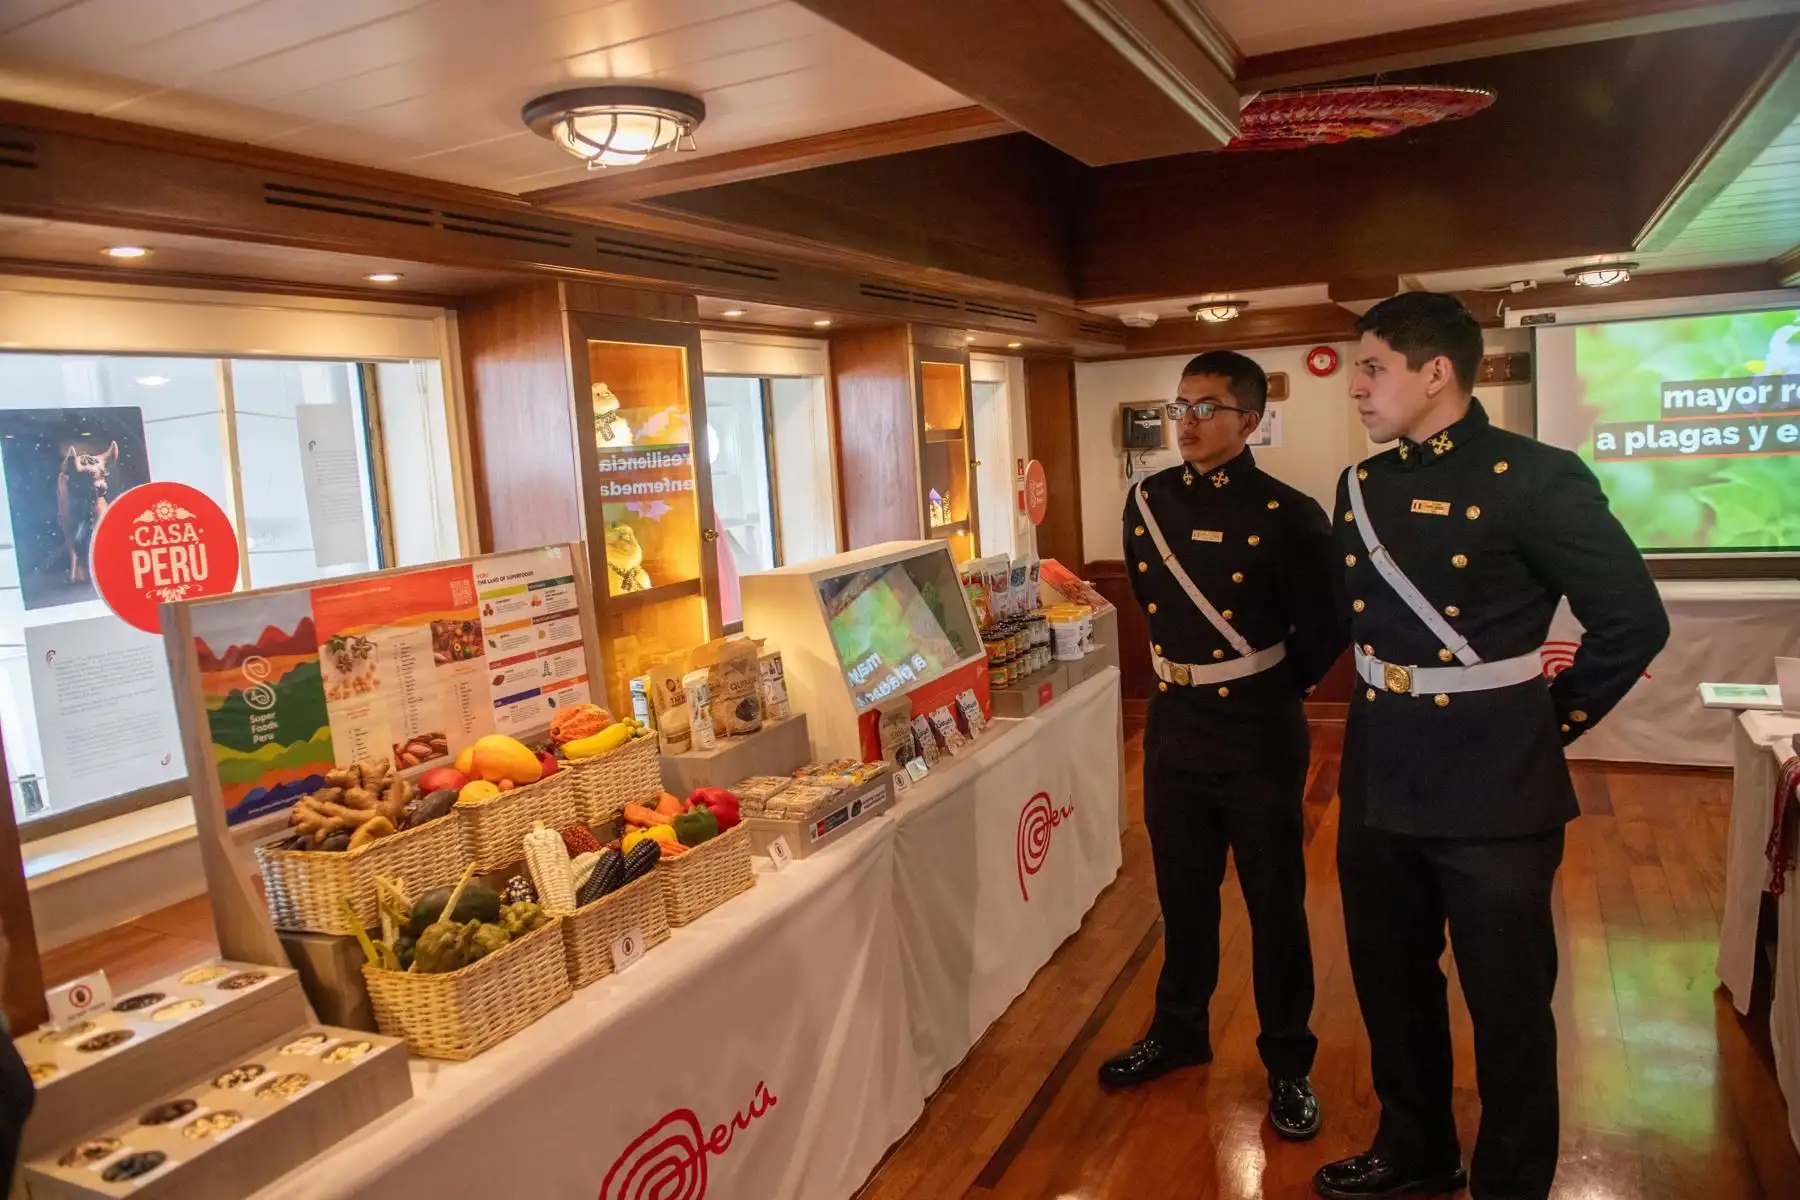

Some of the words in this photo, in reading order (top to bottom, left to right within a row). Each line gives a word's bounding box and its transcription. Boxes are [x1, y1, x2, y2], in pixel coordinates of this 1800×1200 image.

[1663, 381, 1773, 412] mayor
[1596, 431, 1617, 450] a
[1624, 424, 1740, 455] plagas
[1747, 424, 1768, 451] y
[135, 522, 200, 547] CASA
[131, 541, 208, 589] PERÚ
[250, 712, 276, 723] Super
[251, 721, 279, 733] Foods
[253, 733, 275, 744] Peru
